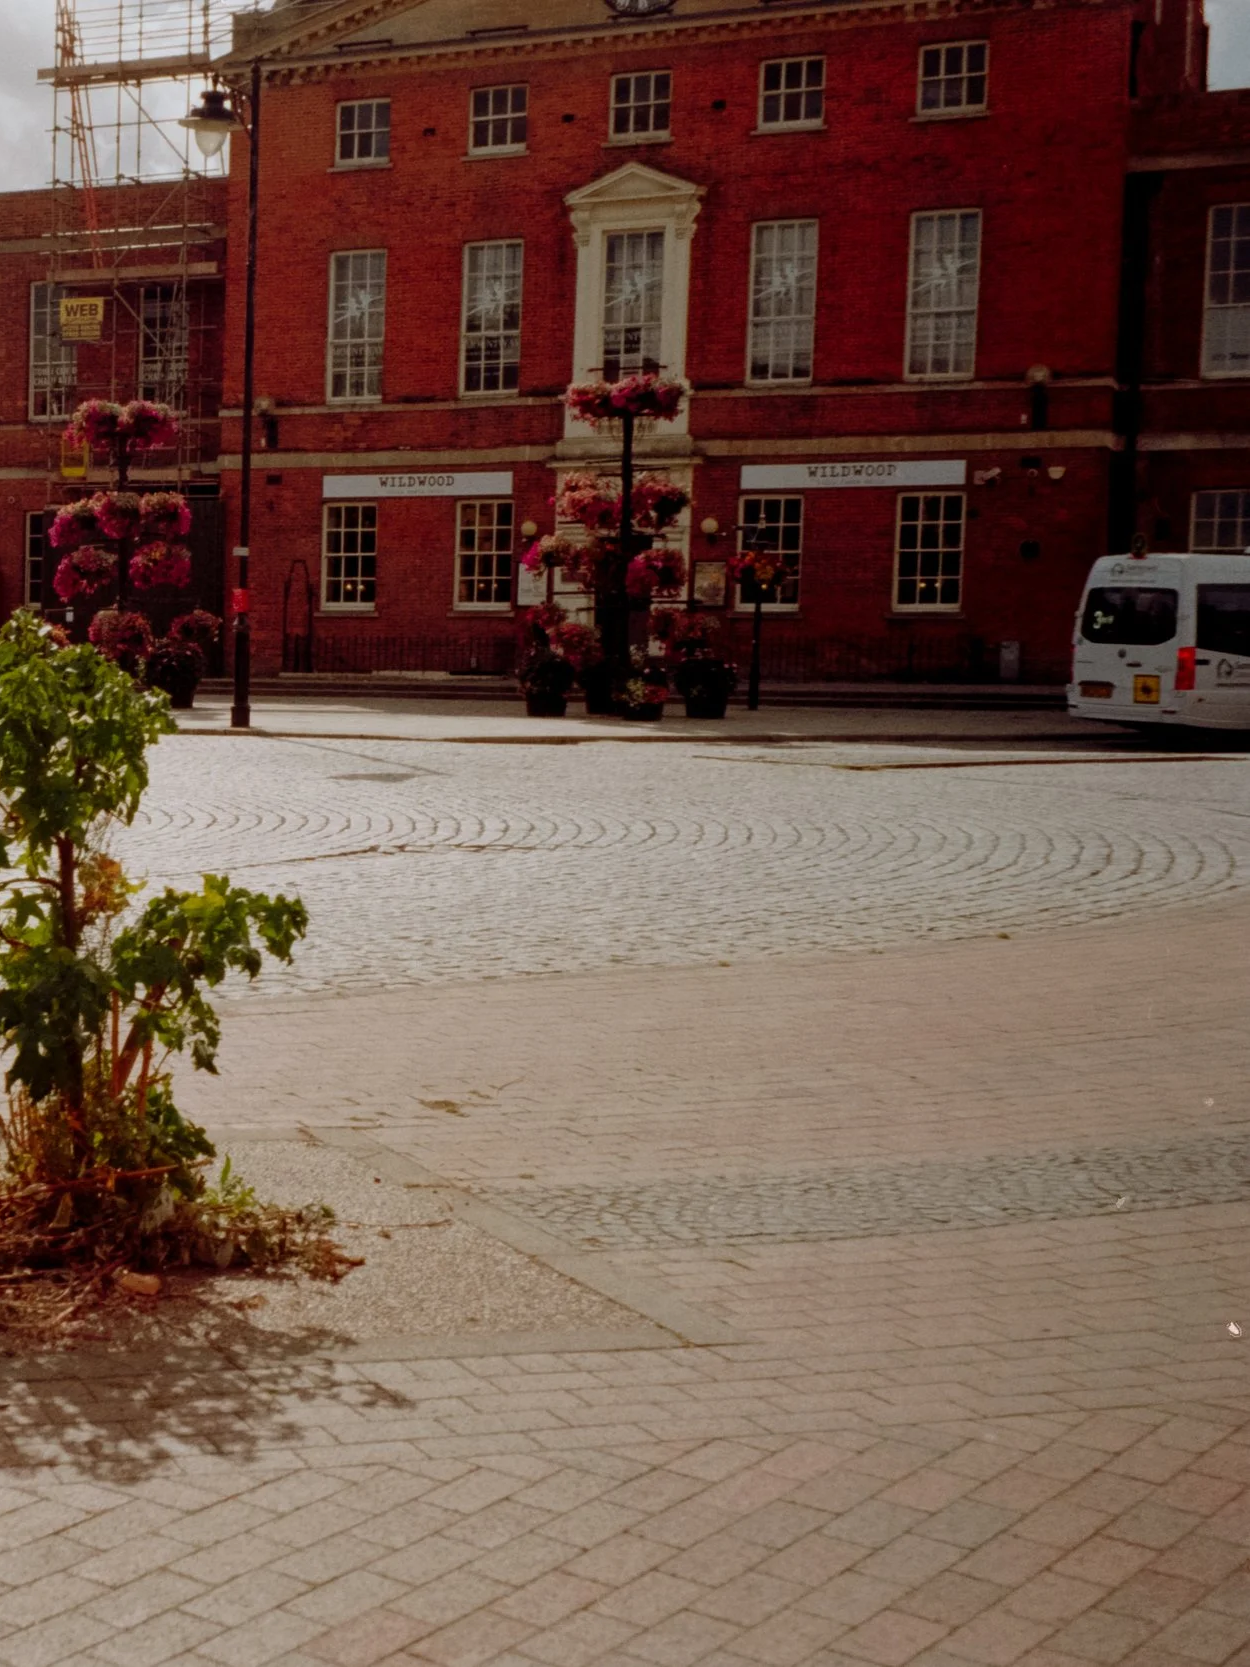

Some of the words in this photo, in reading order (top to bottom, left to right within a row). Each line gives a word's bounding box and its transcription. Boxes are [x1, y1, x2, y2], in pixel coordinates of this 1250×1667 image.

[65, 303, 98, 316] WEB
[807, 464, 897, 478] WILDWOOD
[378, 475, 455, 488] WILDWOOD
